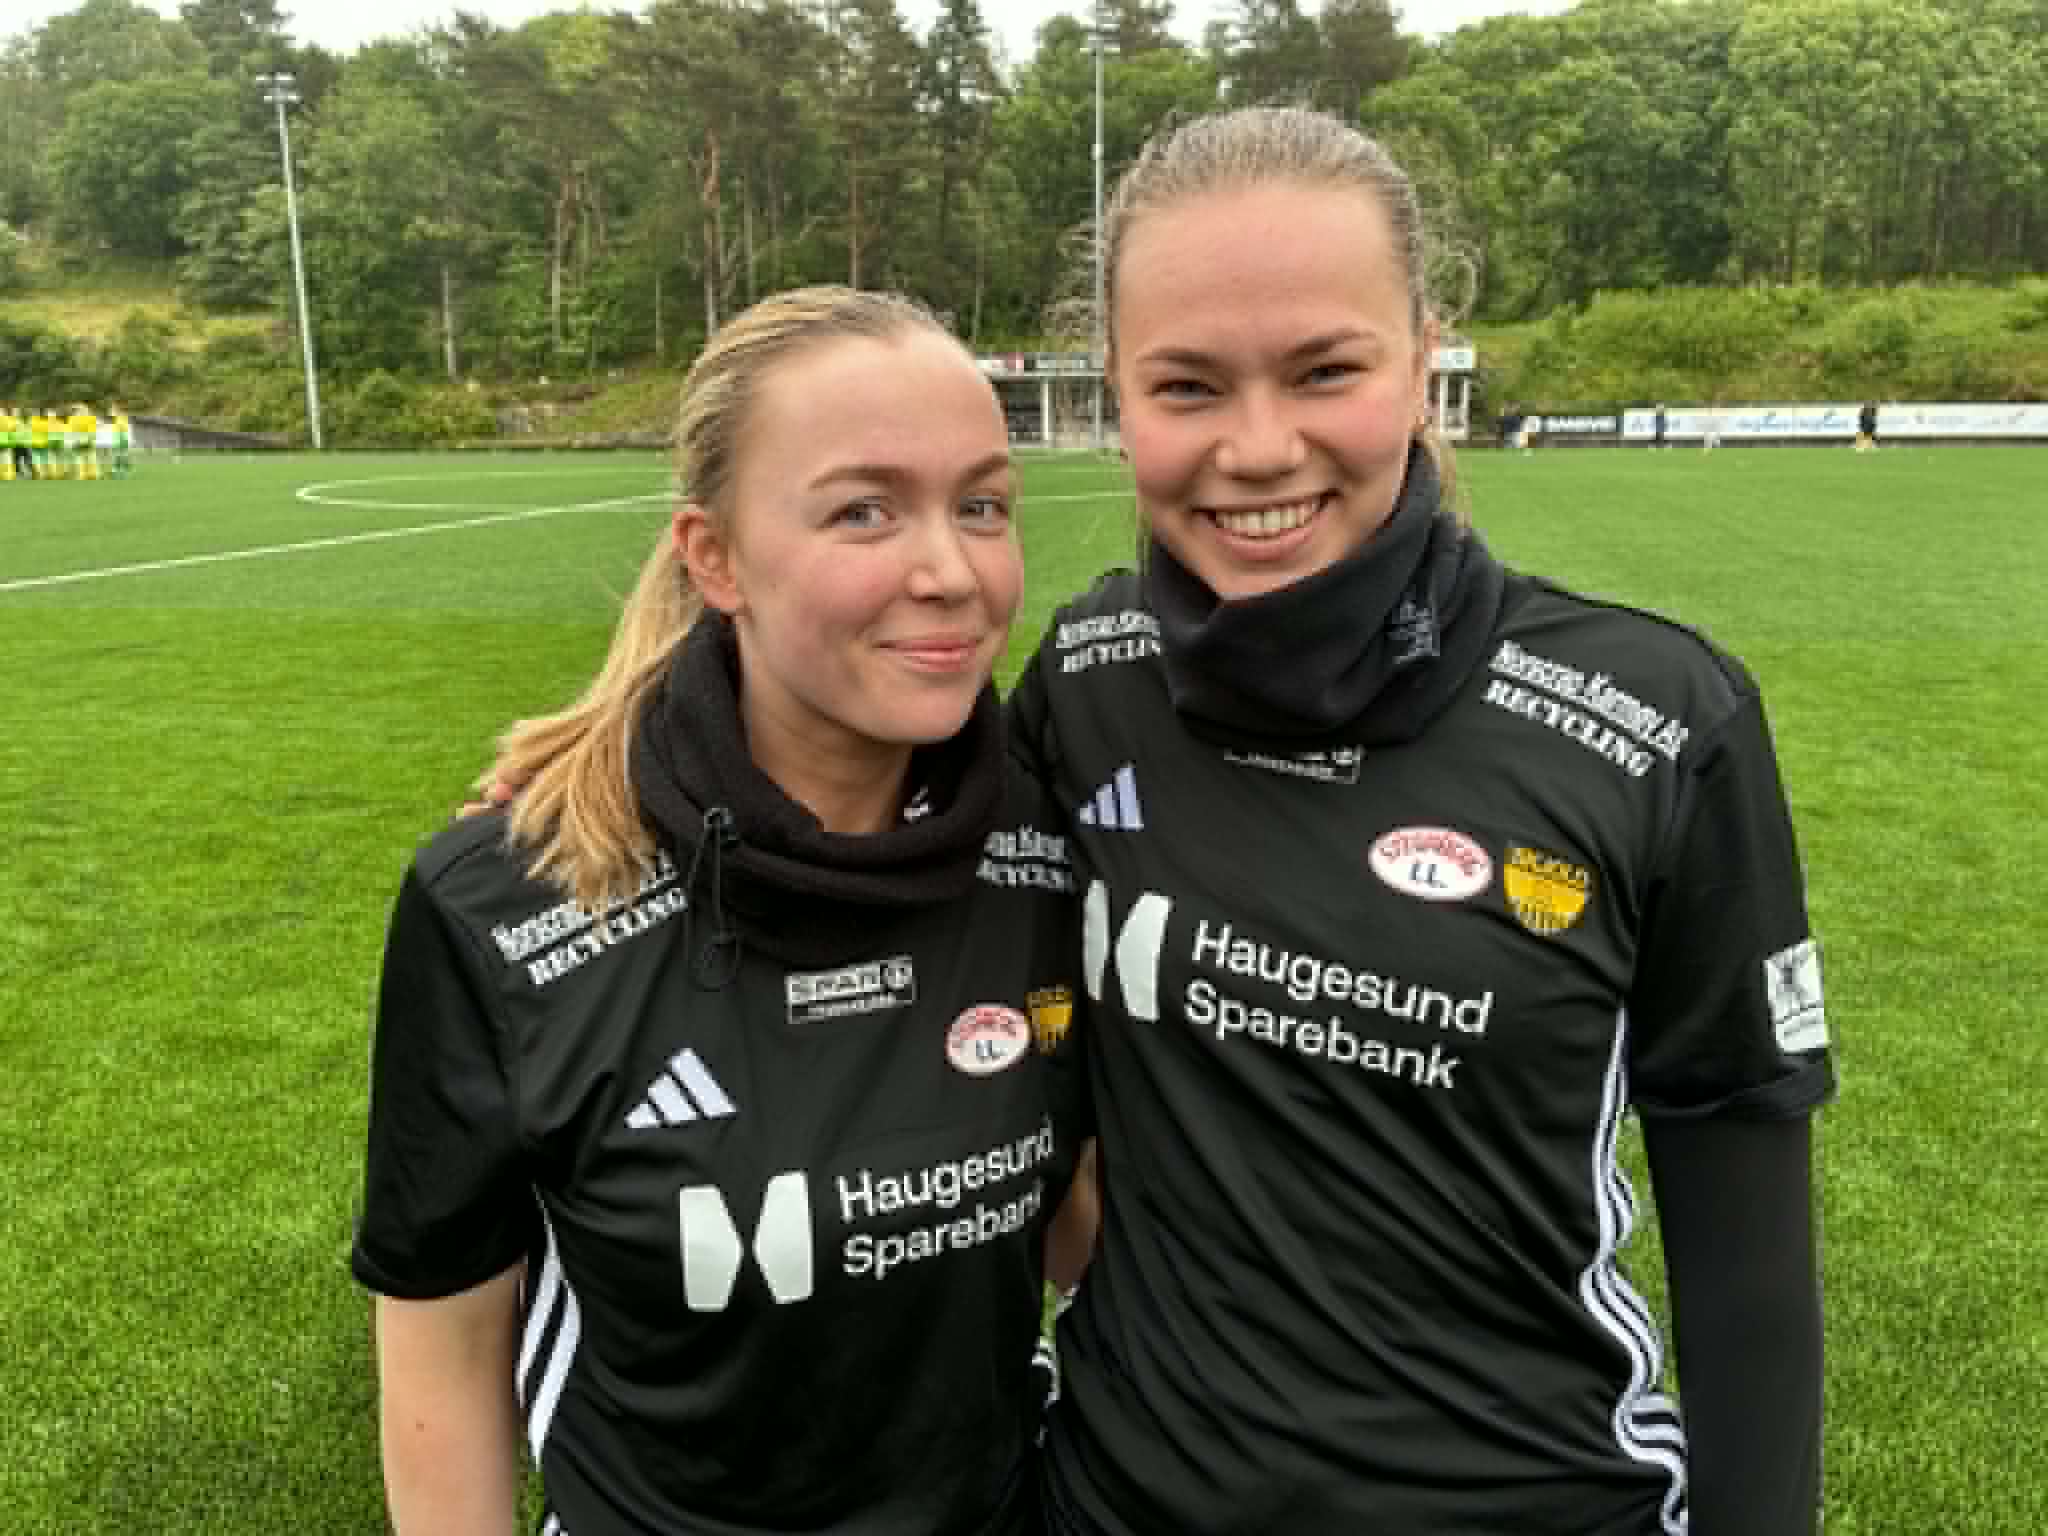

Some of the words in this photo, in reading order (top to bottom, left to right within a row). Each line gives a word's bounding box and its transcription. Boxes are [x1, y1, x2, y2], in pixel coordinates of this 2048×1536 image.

[1482, 679, 1656, 777] RECYCLING
[1192, 918, 1495, 1037] Haugesund
[1185, 978, 1462, 1089] Sparebank
[836, 1112, 1055, 1222] Haugesund
[842, 1177, 1044, 1280] Spareban
